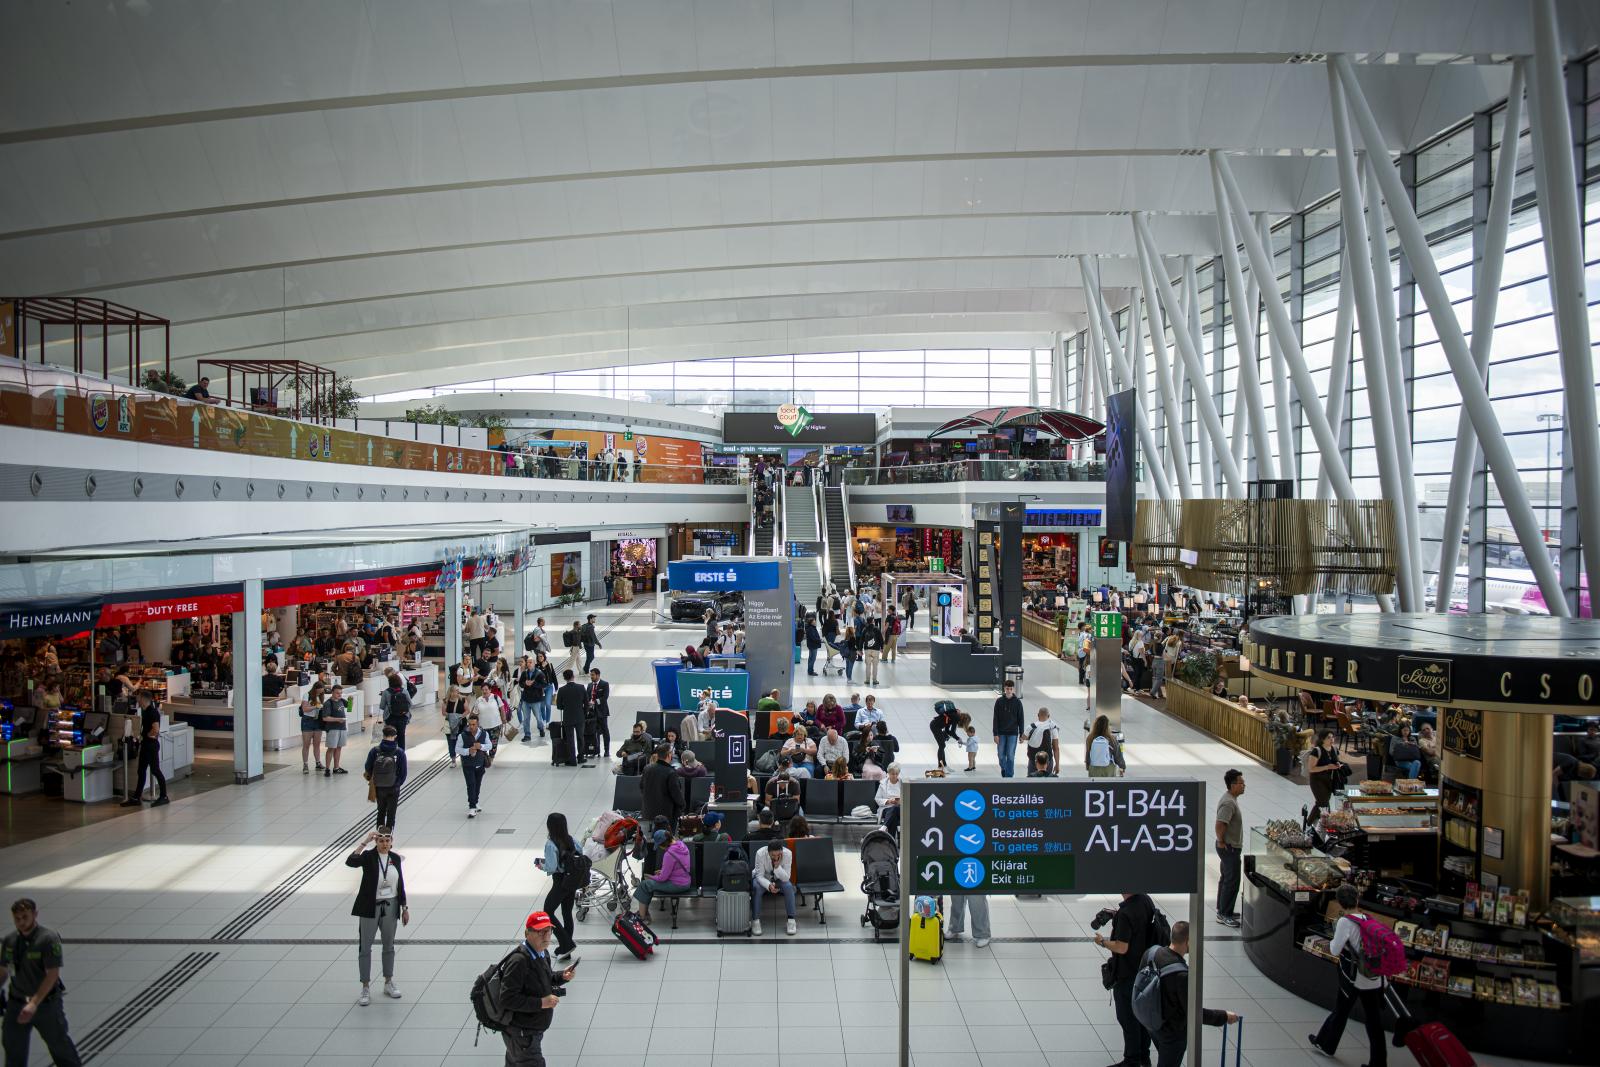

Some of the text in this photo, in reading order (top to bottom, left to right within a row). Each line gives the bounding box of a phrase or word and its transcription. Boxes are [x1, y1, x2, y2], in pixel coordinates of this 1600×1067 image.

[404, 576, 426, 586] DUTY FREE
[694, 572, 725, 582] ERSTE
[325, 584, 365, 596] TRAVEL VALUE
[147, 603, 199, 616] DUTY FREE
[9, 611, 91, 629] HEINEMANN
[1401, 668, 1448, 695] Szamos
[690, 688, 720, 699] ERTE
[992, 794, 1044, 805] Beszállás
[1084, 789, 1187, 817] B1-B44
[992, 808, 1006, 818] To
[1008, 808, 1039, 820] gates
[991, 827, 1044, 838] Beszállás
[1084, 823, 1193, 852] A1-A33
[991, 842, 1006, 852] To
[1008, 842, 1039, 854] gates
[991, 860, 1028, 872] Kijárat
[991, 873, 1035, 884] Exit 出口
